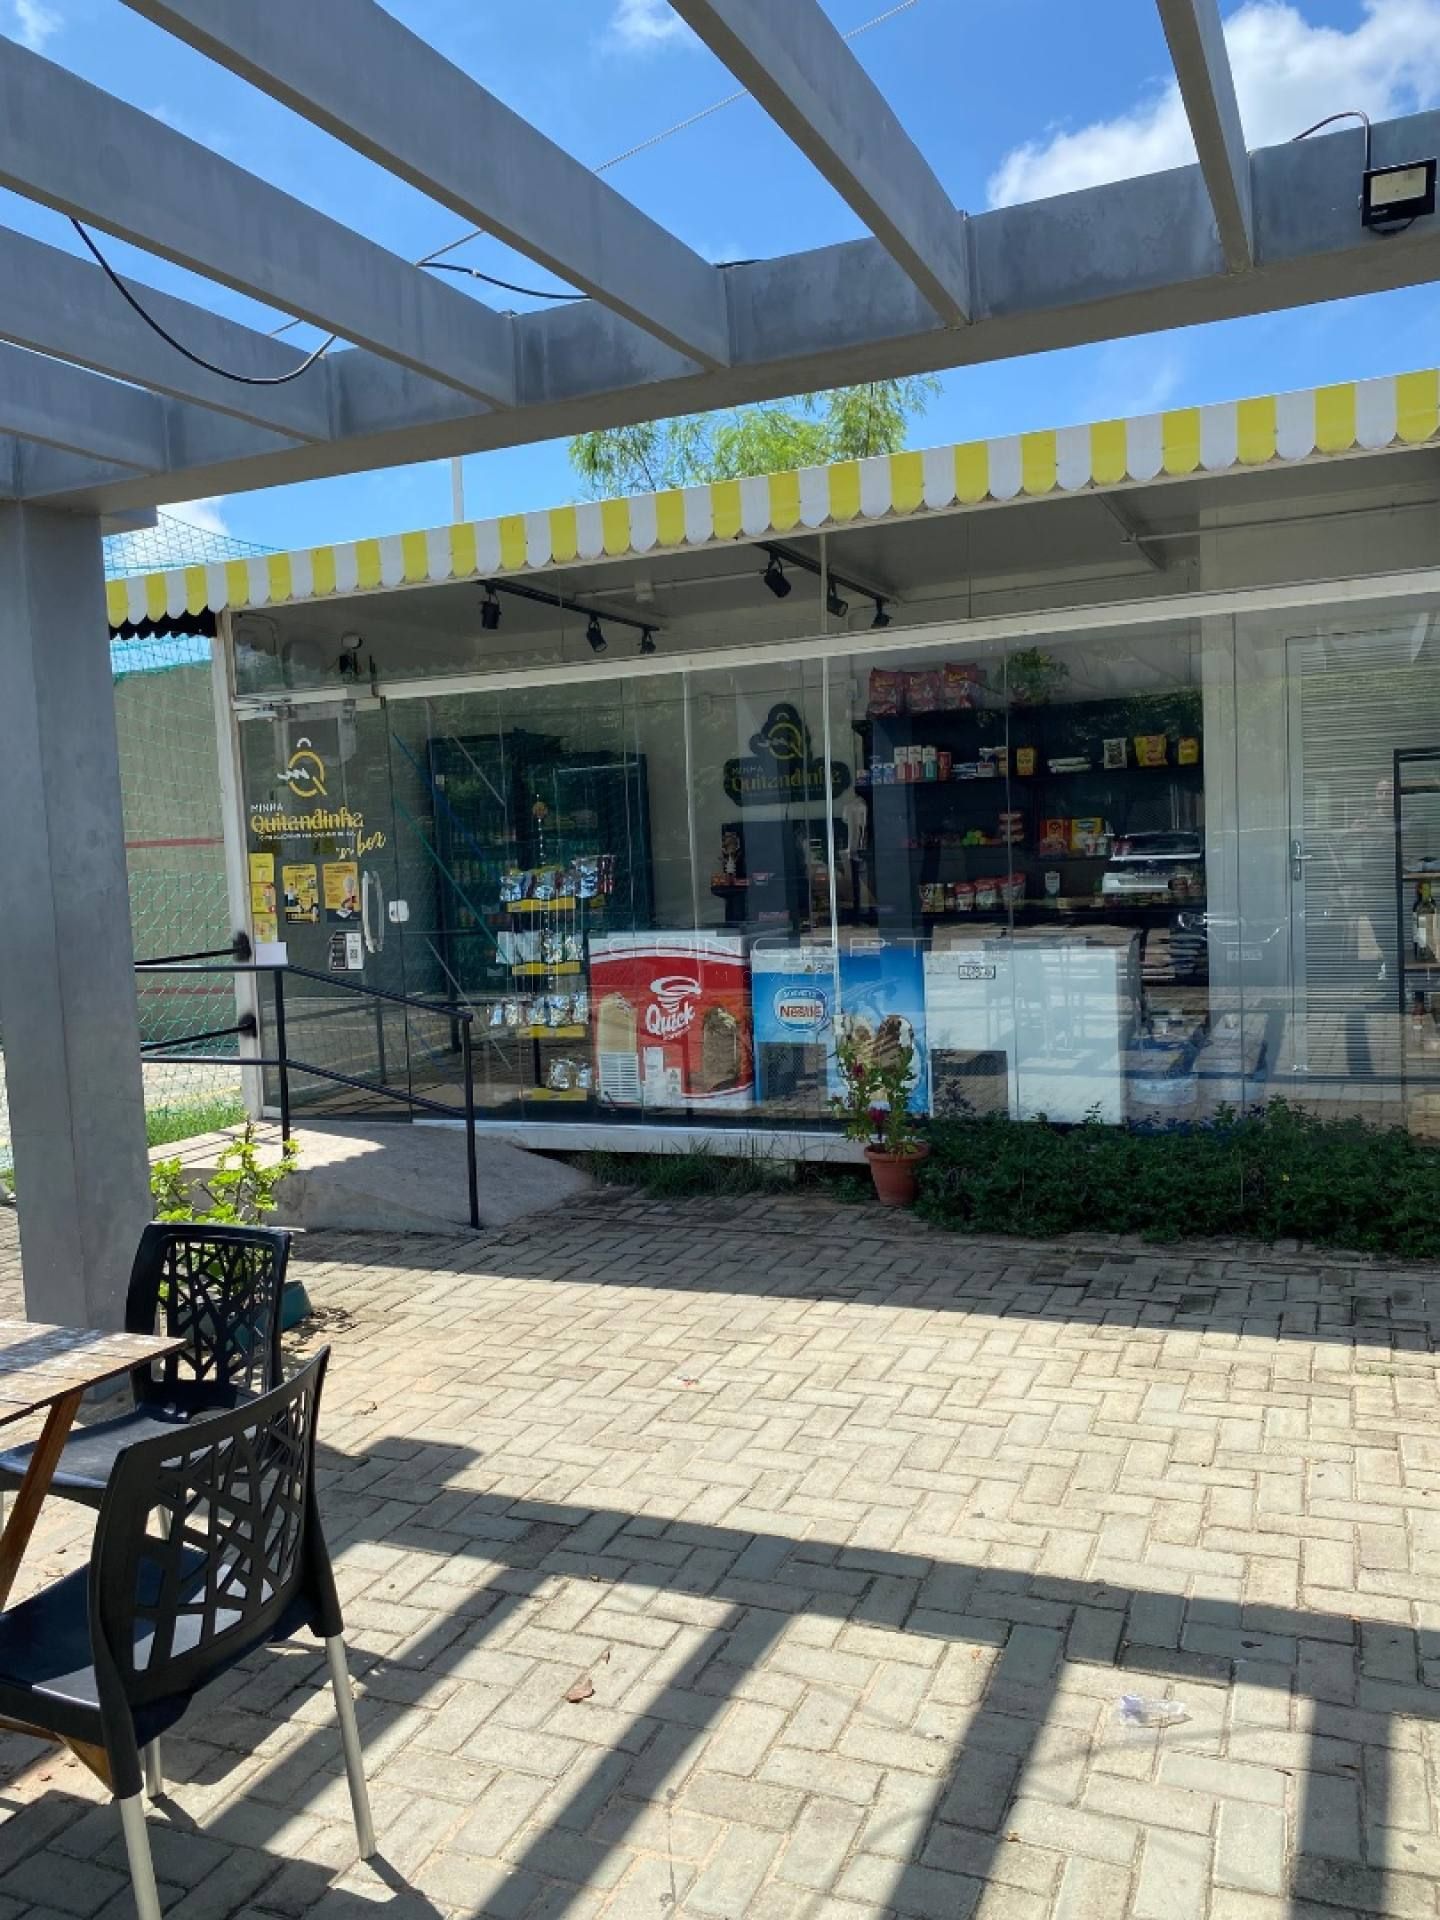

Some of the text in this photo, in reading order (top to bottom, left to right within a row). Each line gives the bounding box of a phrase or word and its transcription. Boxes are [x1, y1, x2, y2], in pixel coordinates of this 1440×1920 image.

[250, 802, 285, 813] MINHA
[251, 806, 365, 833] Quitandinha
[644, 1000, 696, 1036] Quick
